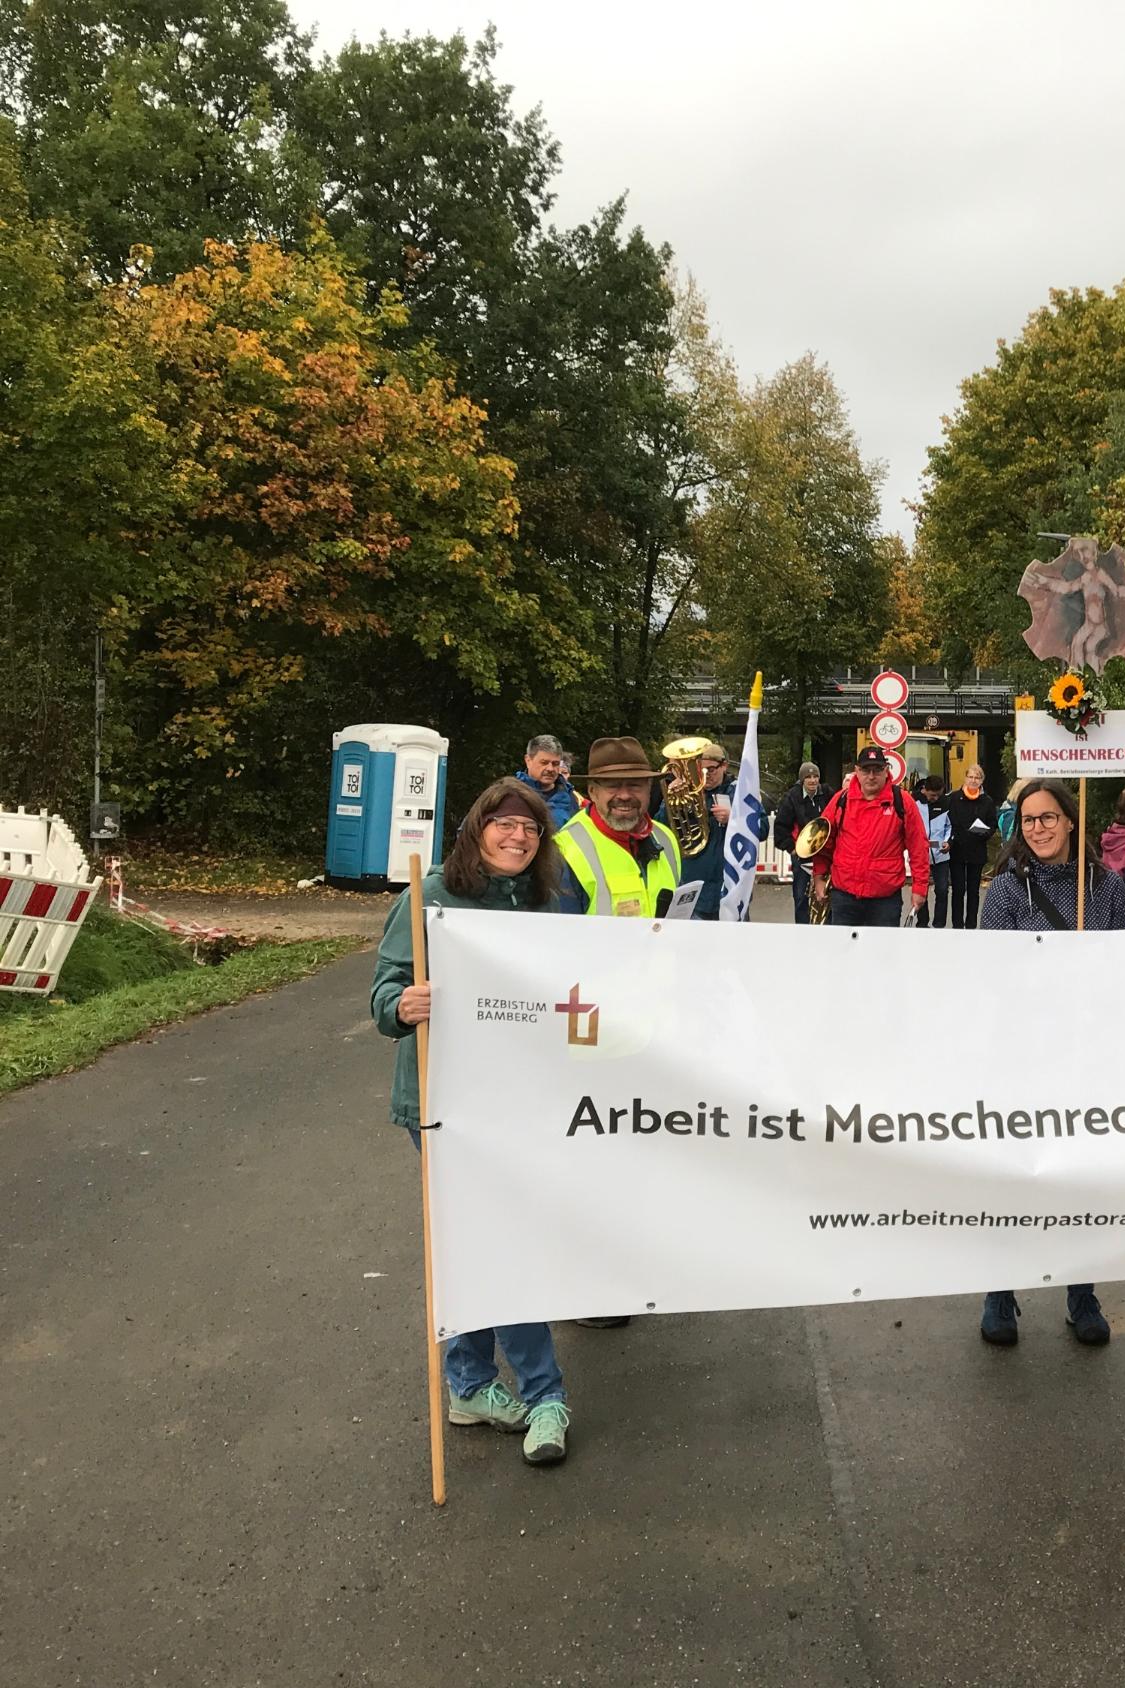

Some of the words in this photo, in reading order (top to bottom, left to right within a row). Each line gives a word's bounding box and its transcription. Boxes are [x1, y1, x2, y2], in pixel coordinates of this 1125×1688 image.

[477, 998, 547, 1012] ERZBISTUM
[477, 1010, 538, 1023] BAMBERG
[565, 1096, 731, 1138] Arbeit
[747, 1104, 807, 1142] ist
